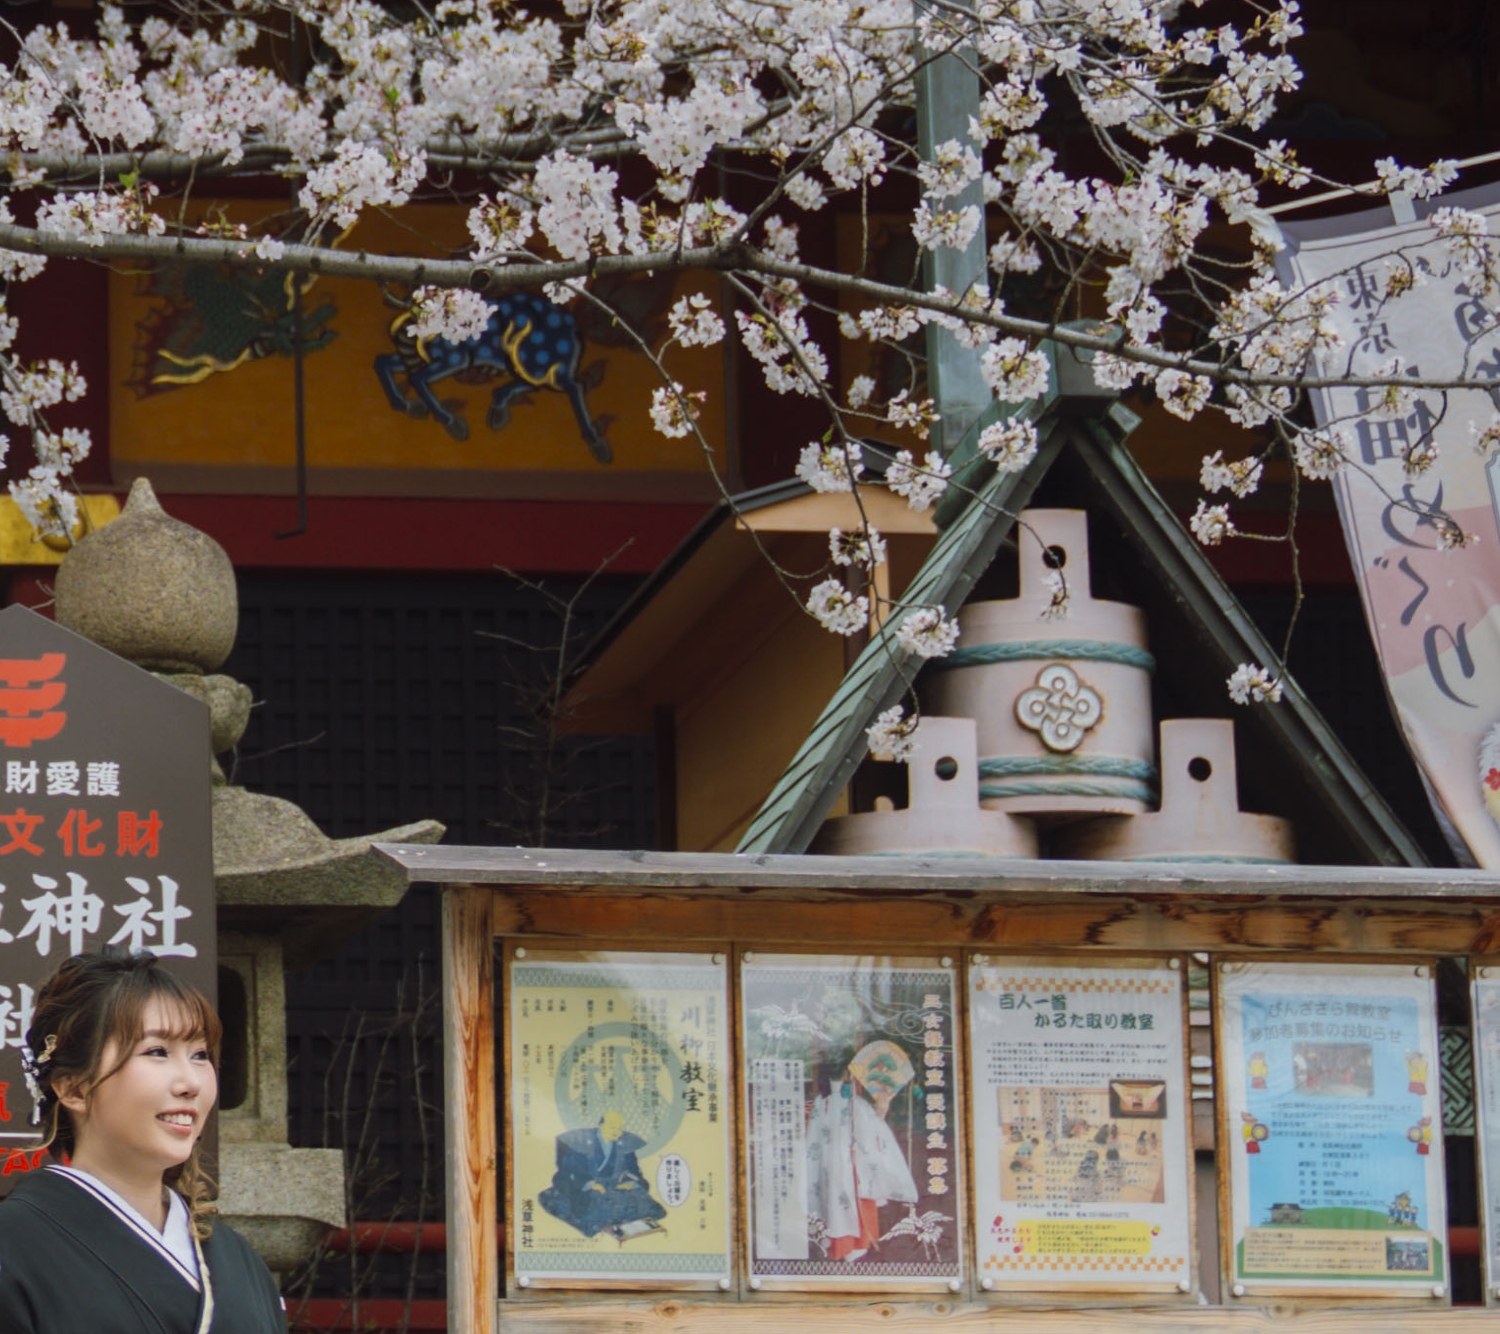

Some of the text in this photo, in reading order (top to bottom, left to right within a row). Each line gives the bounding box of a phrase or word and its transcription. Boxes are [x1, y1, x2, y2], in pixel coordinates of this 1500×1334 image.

[999, 993, 1067, 1011] 百人一首
[1034, 1012, 1154, 1031] かるた取り教室
[1250, 1023, 1404, 1044] 参加者募集のお知らせ
[679, 1005, 705, 1113] 川柳教室
